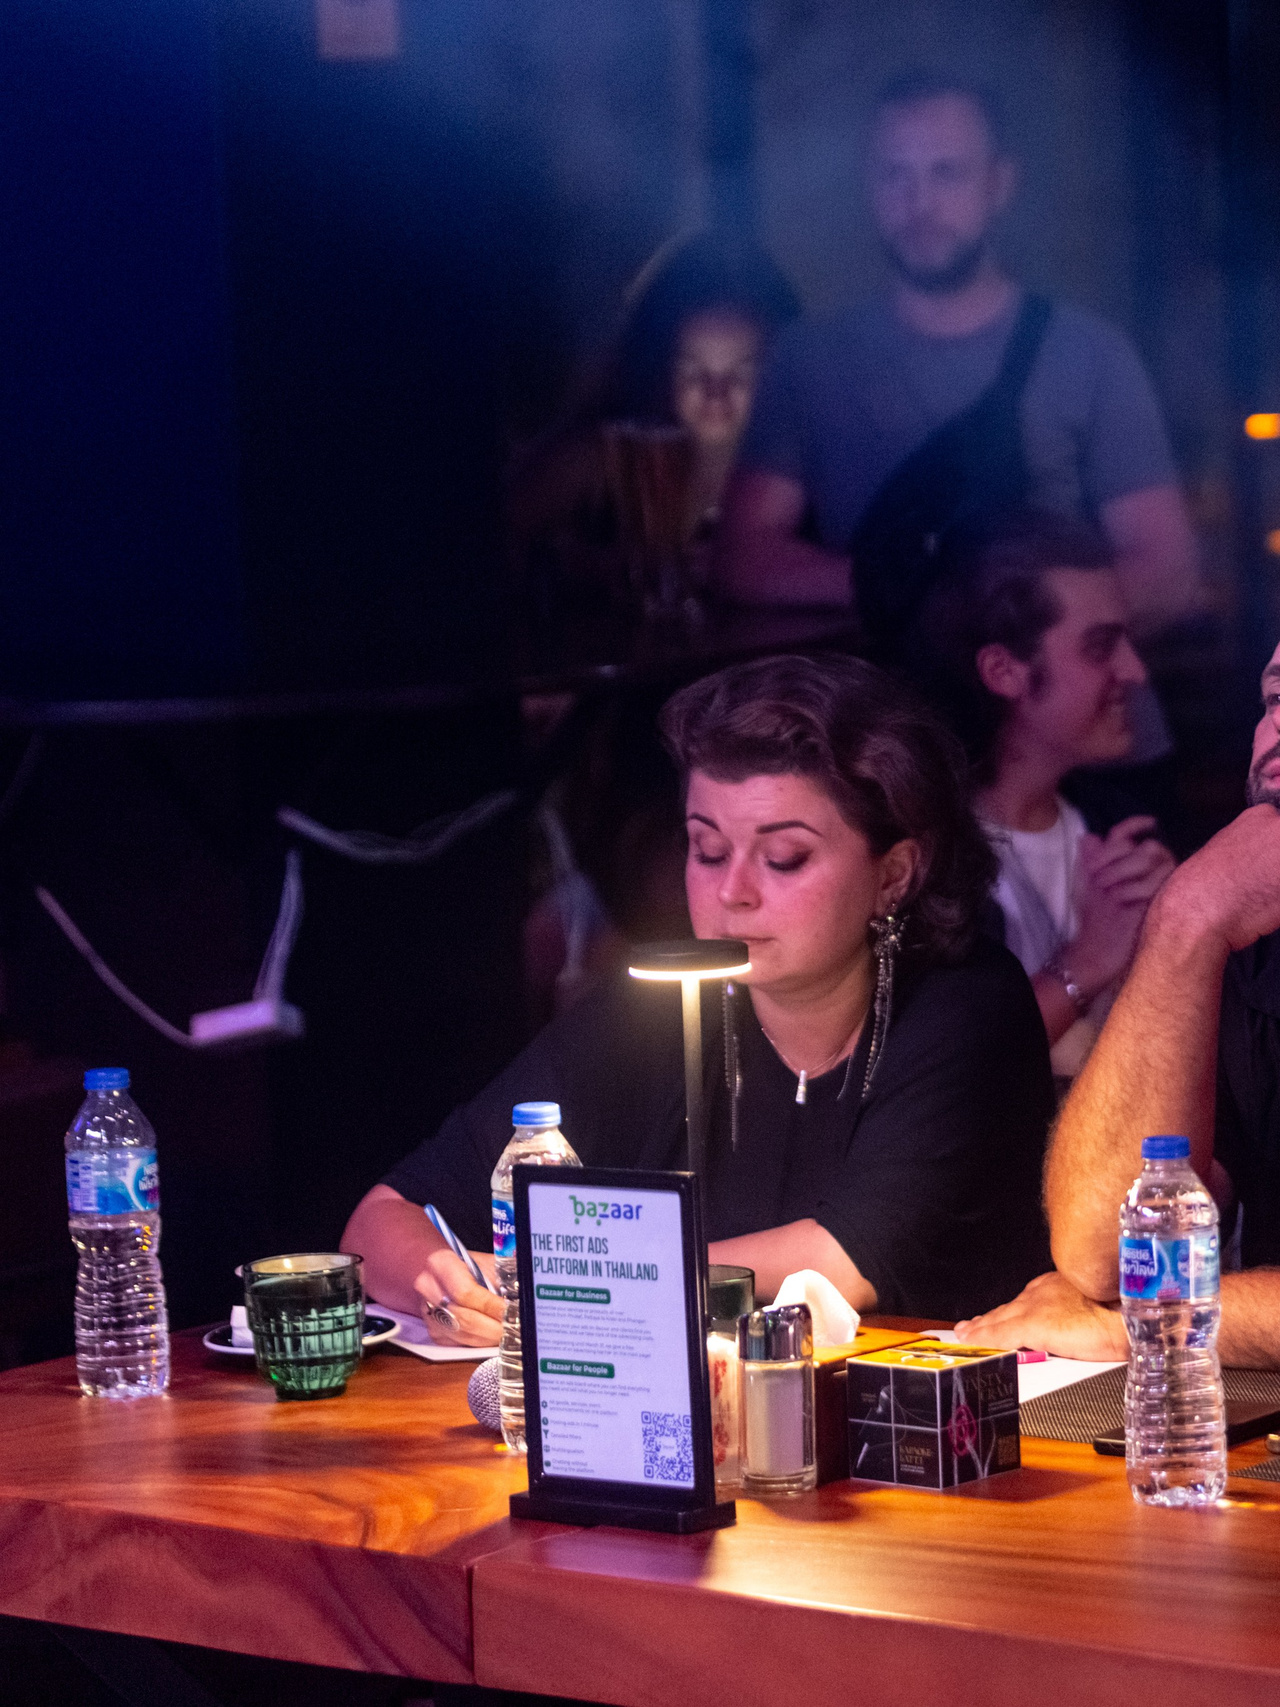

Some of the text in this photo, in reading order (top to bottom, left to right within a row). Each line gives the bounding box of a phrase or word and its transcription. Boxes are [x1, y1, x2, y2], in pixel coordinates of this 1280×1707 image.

[568, 1195, 643, 1221] bazaar
[531, 1233, 609, 1255] THE FIRST ADS
[533, 1256, 659, 1281] PLATFORM IN THAILAND
[539, 1287, 608, 1300] Bazaar for Business
[546, 1362, 608, 1375] Bazaar for People
